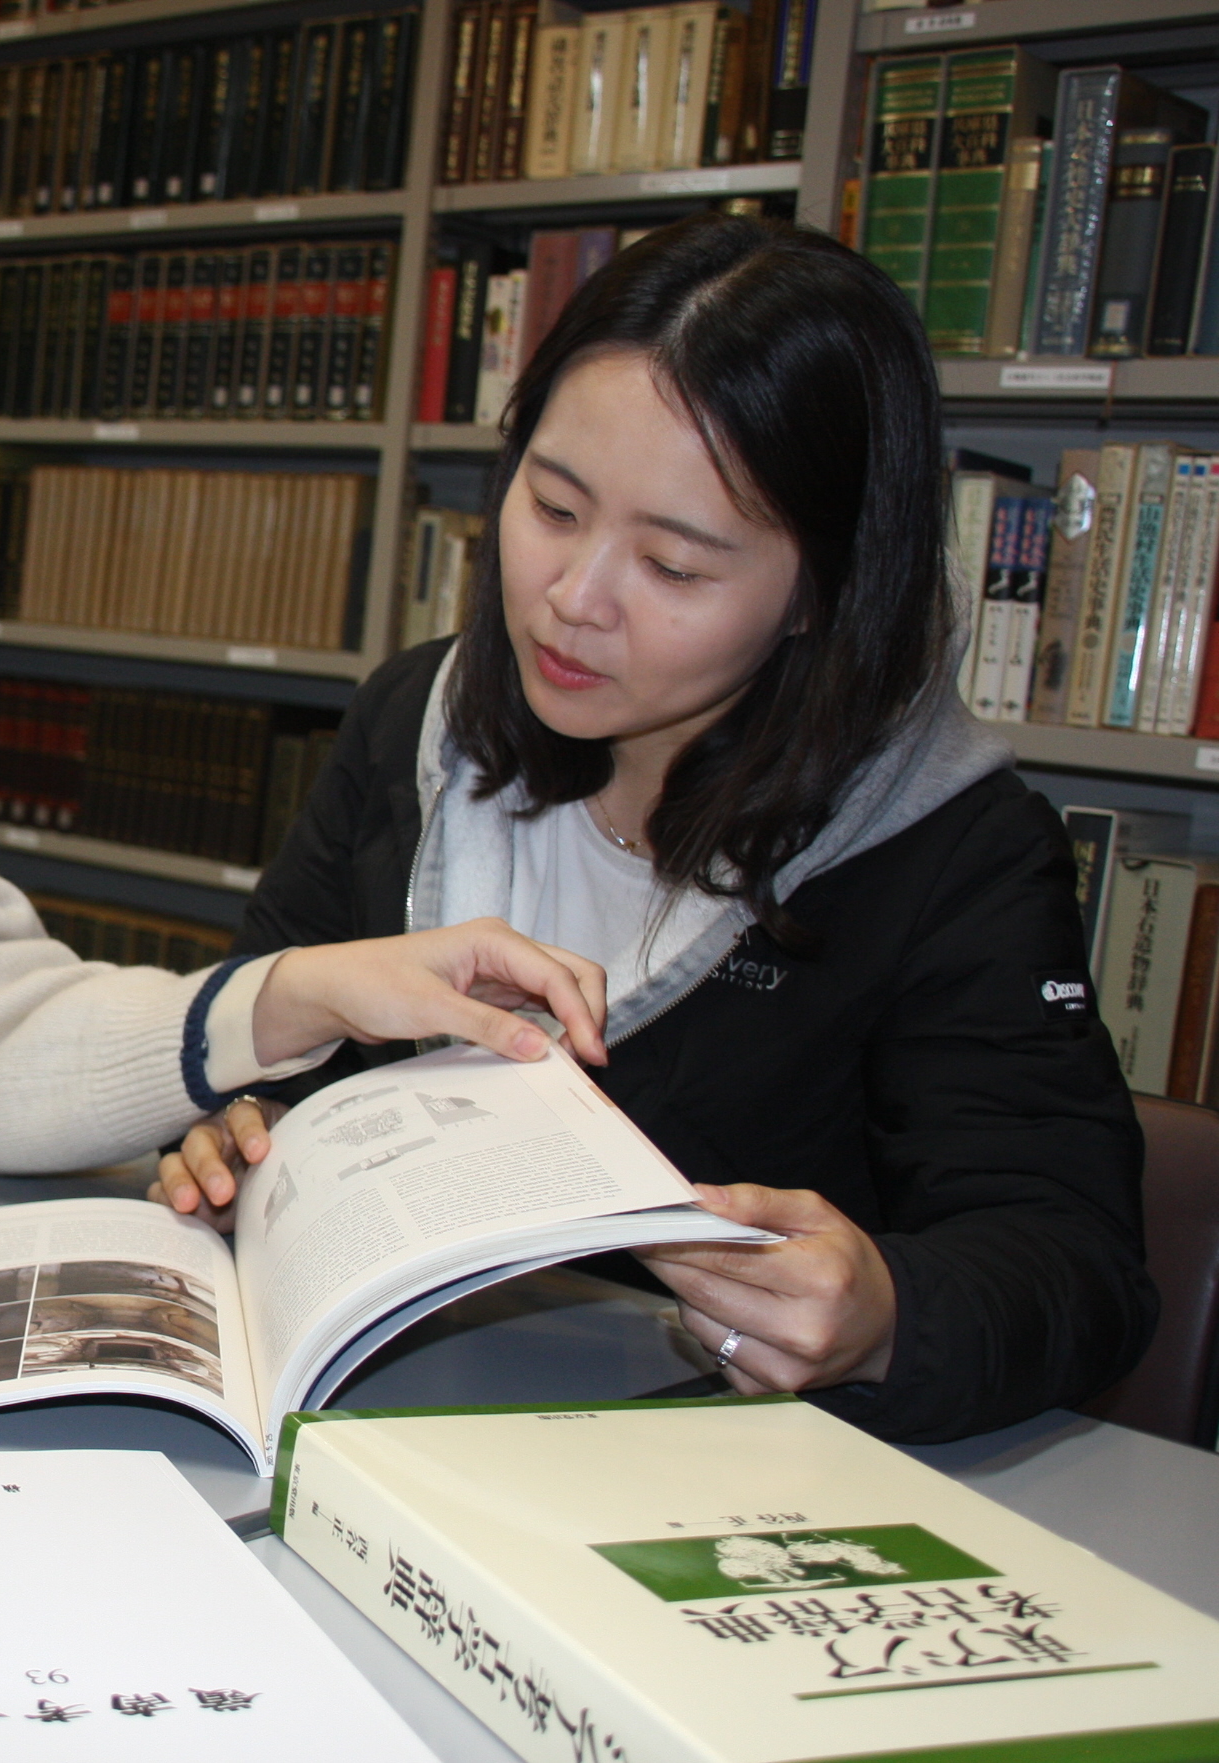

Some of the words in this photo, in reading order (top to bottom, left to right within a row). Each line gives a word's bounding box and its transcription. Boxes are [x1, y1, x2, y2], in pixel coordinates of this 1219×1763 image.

[680, 1583, 1062, 1643] 考古学辞典
[25, 1668, 70, 1685] 93
[826, 1622, 1090, 1680] 東アジア
